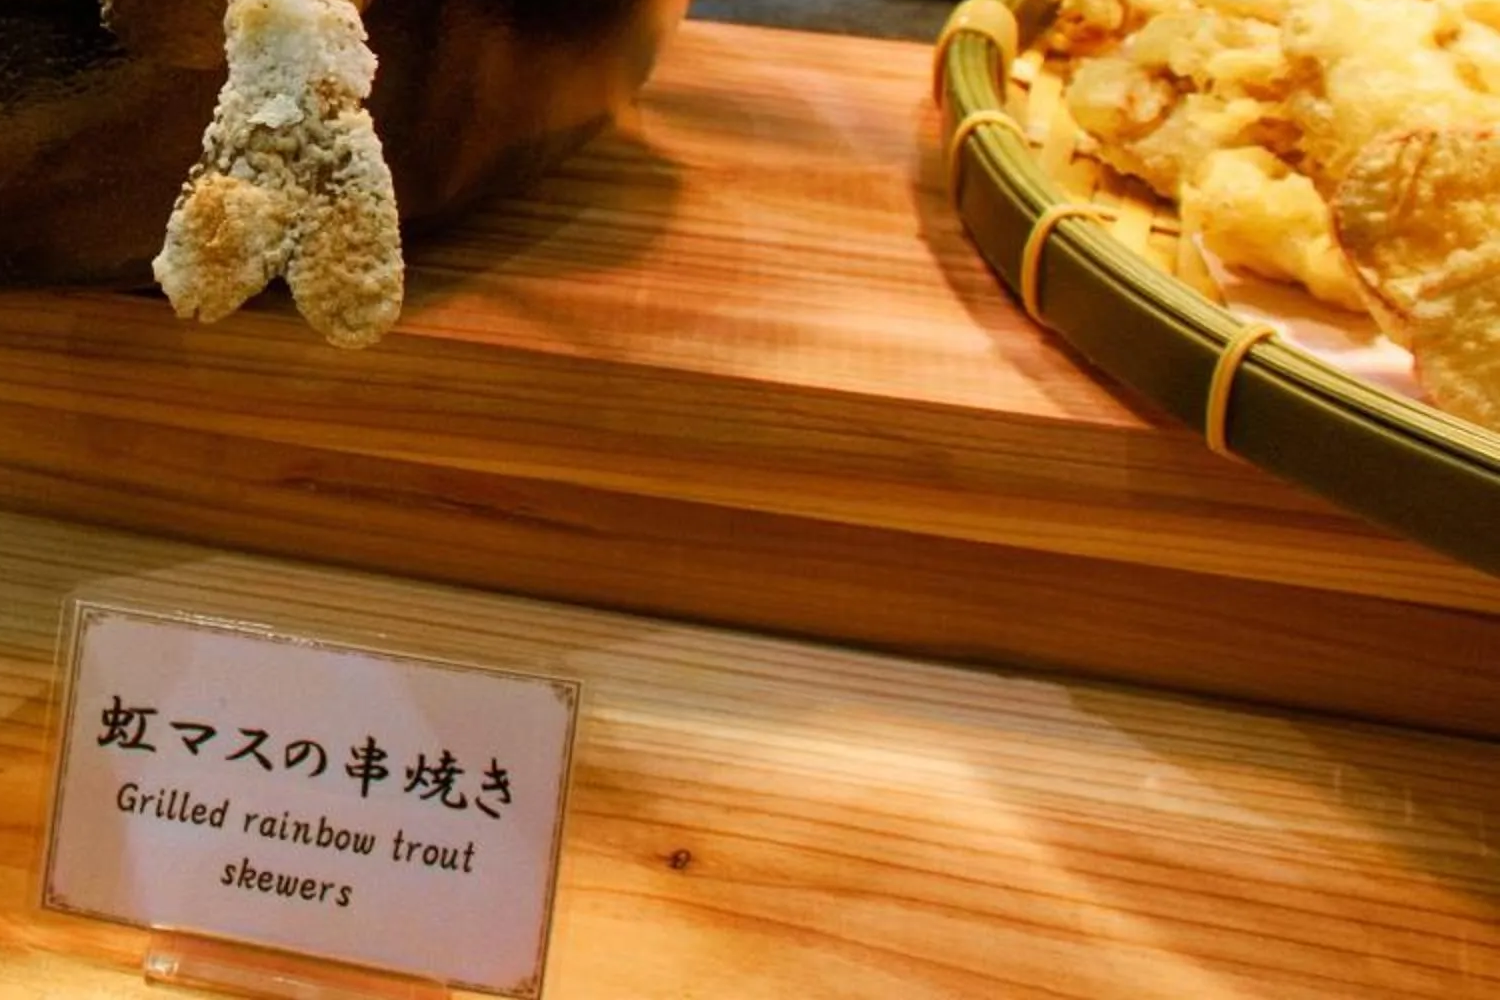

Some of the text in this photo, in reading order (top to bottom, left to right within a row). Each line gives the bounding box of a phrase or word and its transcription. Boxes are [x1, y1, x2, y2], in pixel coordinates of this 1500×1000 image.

[97, 695, 513, 819] 虹マスの串焼き
[116, 783, 476, 872] Grilled rainbow trout
[220, 858, 353, 908] skewers
